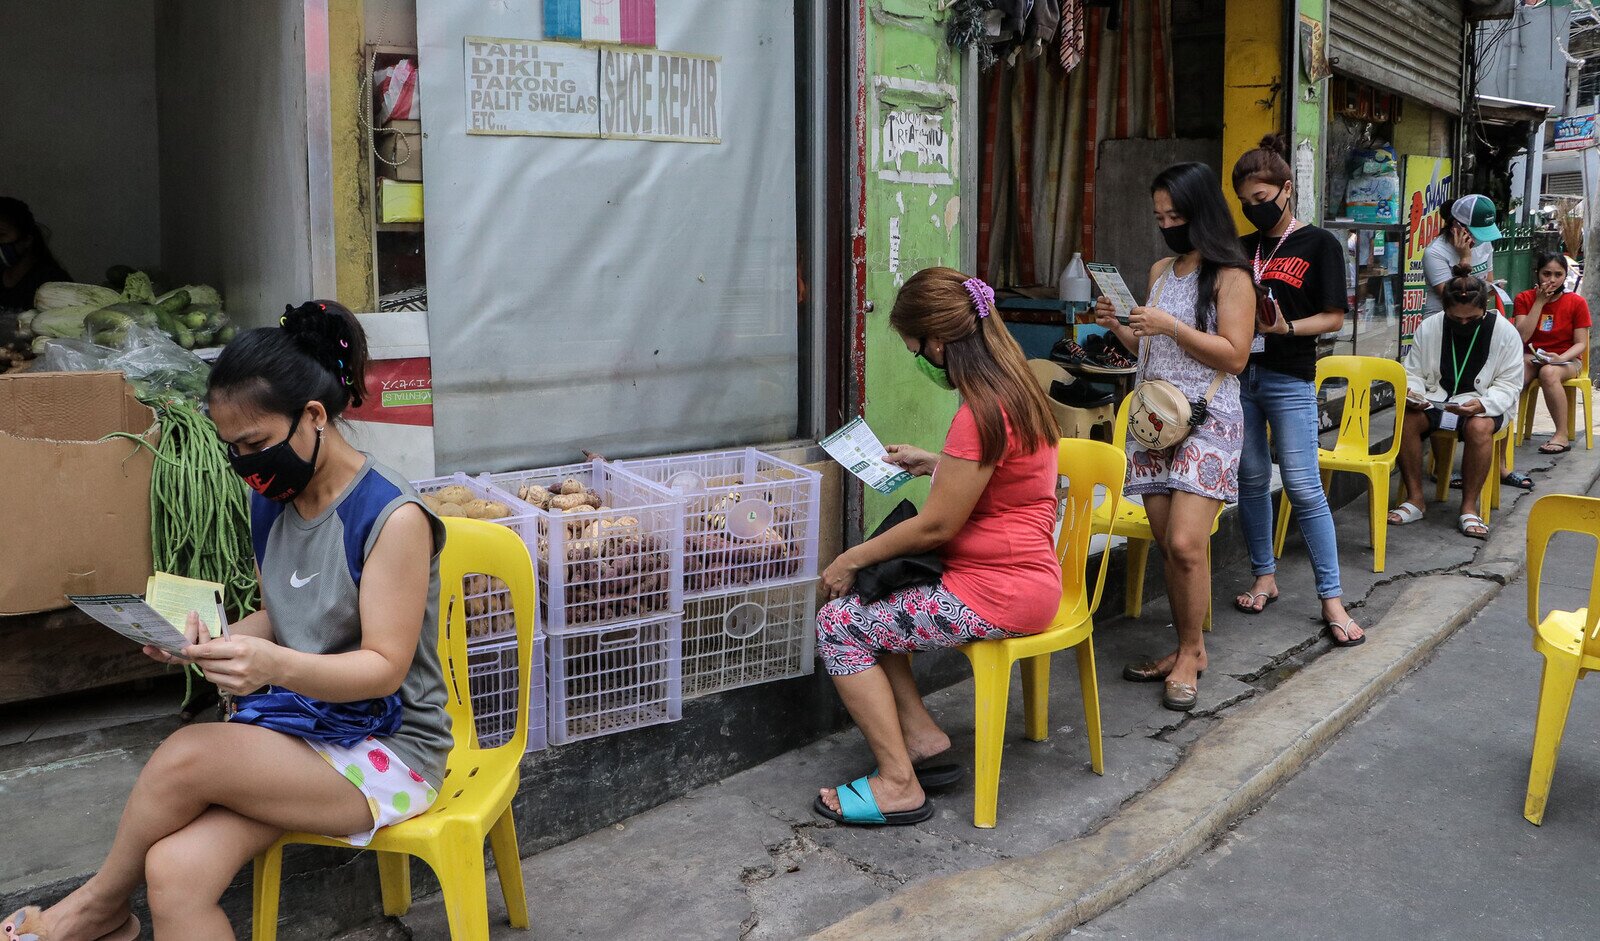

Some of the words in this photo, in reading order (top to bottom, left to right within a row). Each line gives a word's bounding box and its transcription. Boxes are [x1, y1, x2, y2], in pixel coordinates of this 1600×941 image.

[469, 42, 538, 59] TAHI
[471, 58, 564, 78] DIKIT
[471, 75, 576, 94] TAKONG
[604, 50, 653, 134] SHOE
[658, 55, 718, 137] REPAIR
[471, 90, 523, 111] PALIT
[528, 93, 598, 115] SWELAS
